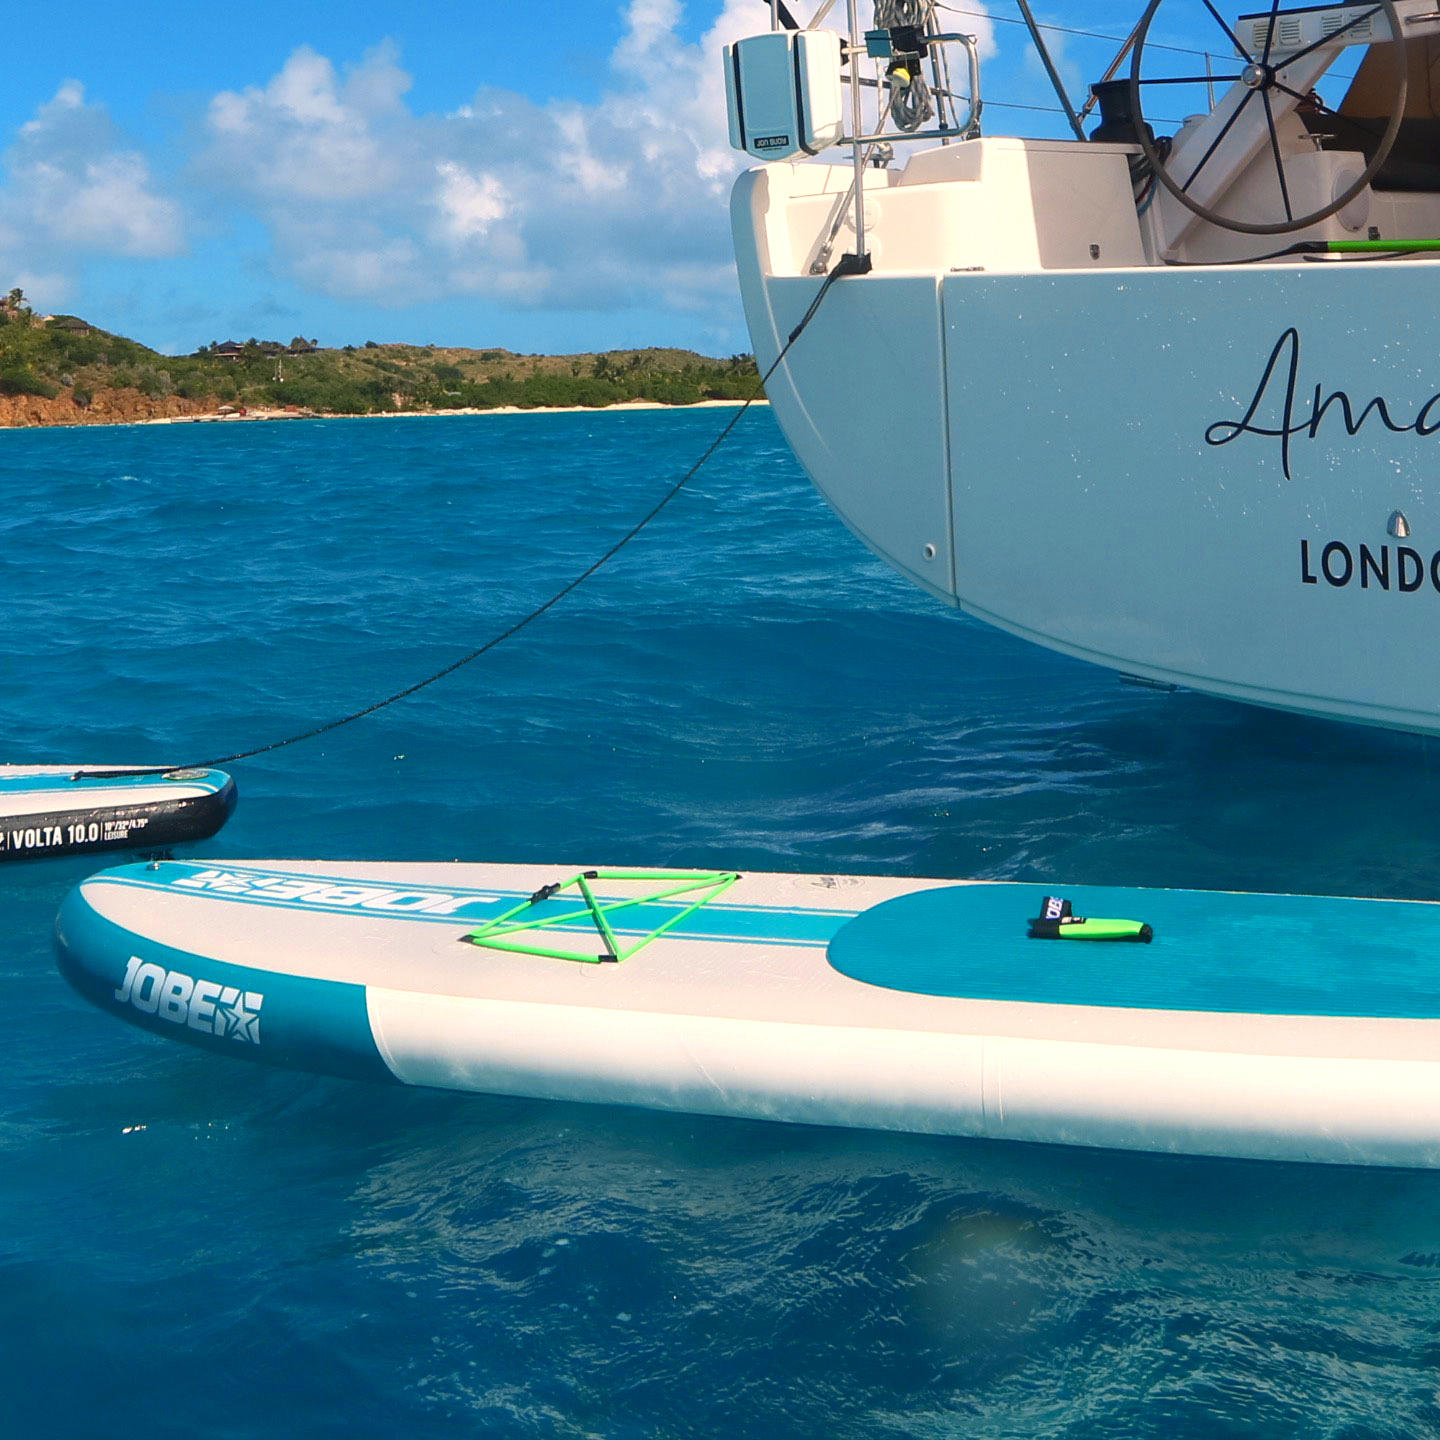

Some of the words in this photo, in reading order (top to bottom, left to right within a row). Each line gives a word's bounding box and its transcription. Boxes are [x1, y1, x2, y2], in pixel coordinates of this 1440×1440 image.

[12, 826, 63, 849] VOLTA
[68, 823, 99, 844] 10.0
[104, 829, 129, 840] LEISURE
[115, 955, 223, 1033] JOBE
